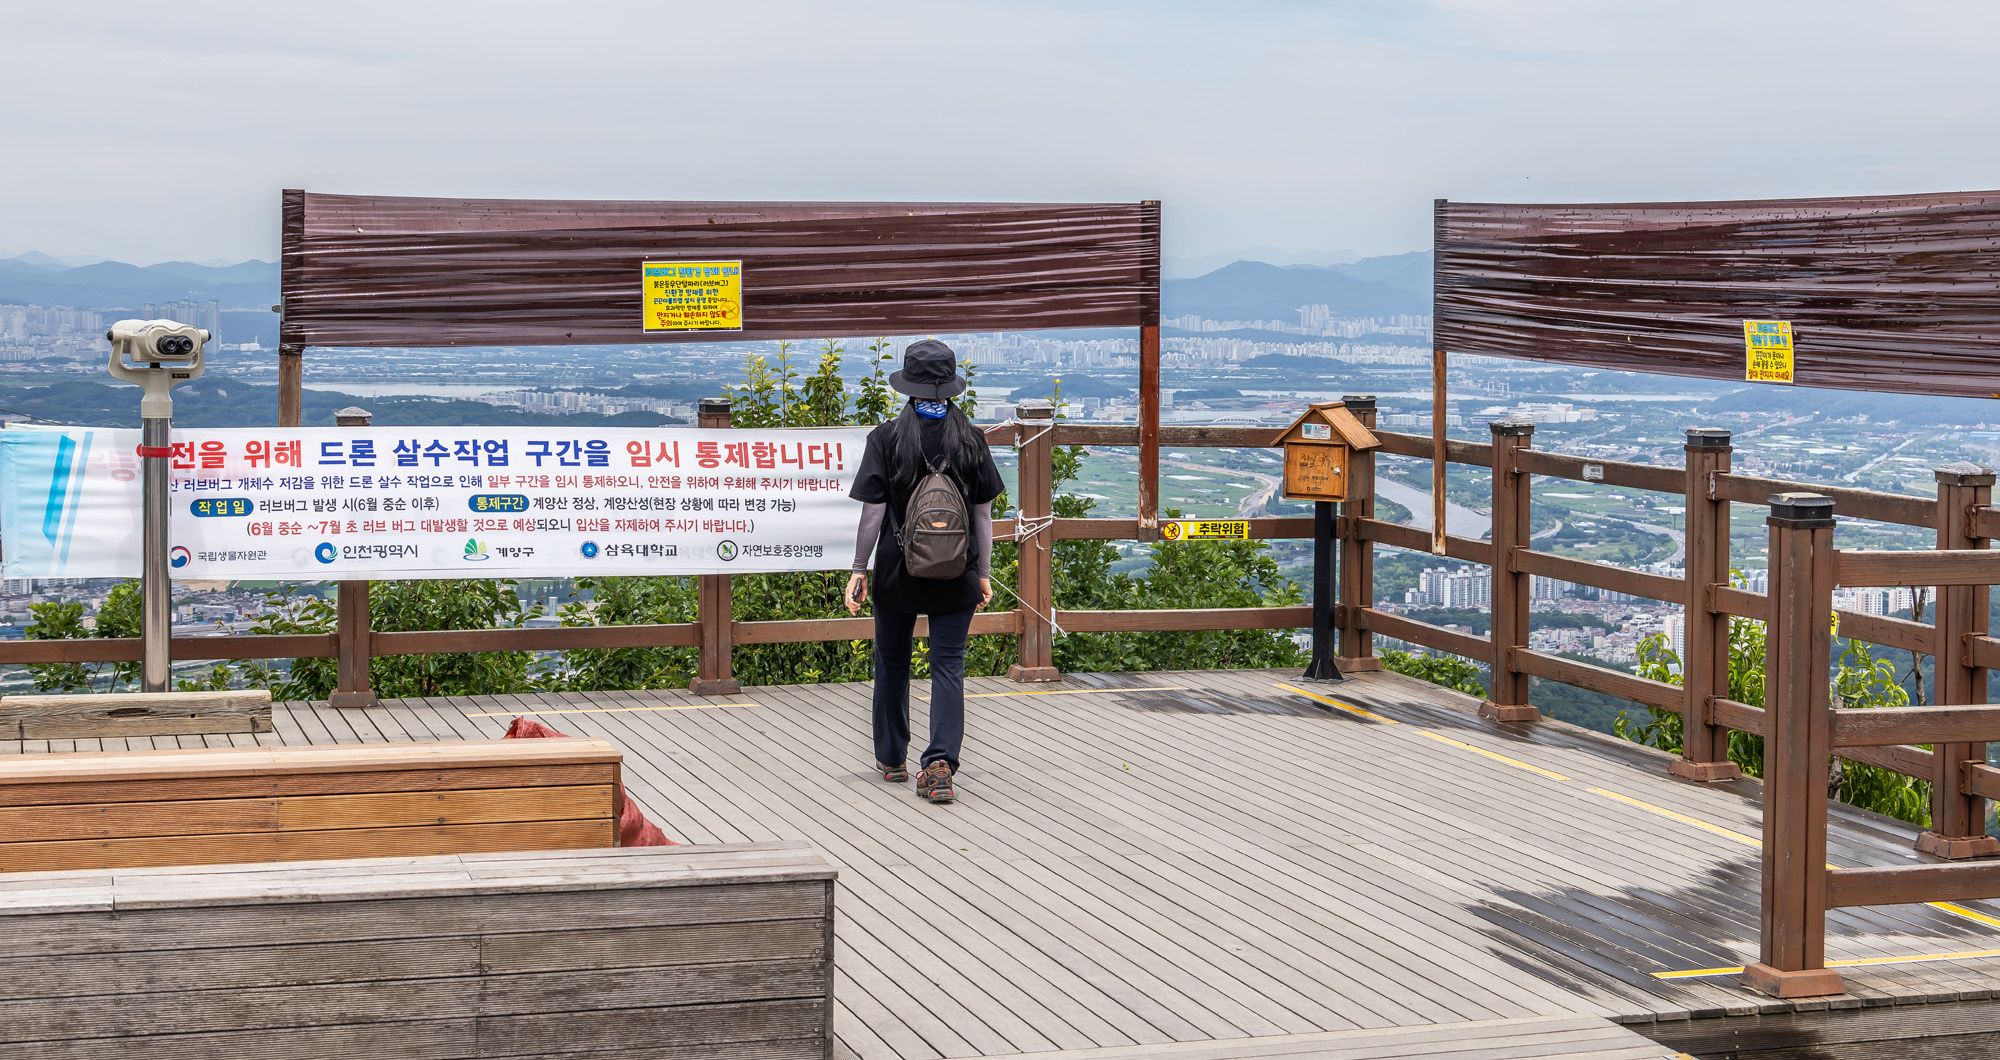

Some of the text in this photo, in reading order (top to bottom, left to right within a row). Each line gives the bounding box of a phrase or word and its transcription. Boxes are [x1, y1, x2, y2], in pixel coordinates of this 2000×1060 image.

[136, 440, 228, 469] 전을
[243, 440, 302, 468] 위해
[318, 439, 377, 467] 드론
[392, 439, 509, 467] 살수작업
[525, 439, 611, 467] 구간을
[626, 440, 680, 468] 임시
[695, 441, 844, 471] 통제합니다!
[184, 478, 233, 492] 러브버그
[238, 477, 274, 491] 개체수
[279, 476, 316, 490] 저감을
[320, 476, 345, 489] 위한
[349, 476, 374, 489] 드론
[378, 475, 402, 489] 살수
[406, 475, 455, 488] 작업으로
[459, 475, 483, 488] 인해
[487, 475, 511, 488] 일부
[515, 475, 551, 488] 구간을
[555, 475, 578, 488] 임시
[582, 475, 644, 489] 통제하오니,
[647, 475, 682, 489] 안전을
[686, 476, 720, 490] 위하여
[723, 477, 757, 490] 우회해
[760, 477, 793, 491] 주시기
[797, 478, 844, 492] 바랍니다.
[259, 499, 308, 513] 러브버그
[312, 498, 337, 512] 발생
[342, 497, 378, 511] 시(6월
[382, 497, 407, 511] 중순
[411, 497, 440, 511] 이후)
[476, 496, 796, 512] 통제구간 계양산 정상, 계양산성(현장 상황에 따라 변경 가능)
[246, 521, 274, 536] (6월
[278, 522, 303, 536] 중순
[345, 520, 358, 533] 초
[363, 519, 387, 533] 러브
[391, 519, 416, 533] 버그
[420, 518, 469, 533] 대발생할
[473, 518, 509, 532] 것으로
[513, 518, 571, 532] 예상되오니
[575, 518, 611, 532] 입산을
[614, 518, 660, 532] 자제하여
[664, 518, 699, 532] 주시기
[702, 519, 755, 533] 바랍니다.)
[1198, 522, 1244, 535] 추락위험
[197, 550, 268, 562] 국립생물자원관
[343, 544, 419, 560] 인천광역시
[495, 547, 535, 558] 계양구
[604, 544, 678, 557] 삼육대학교
[741, 544, 824, 558] 자연보호중앙연맹
